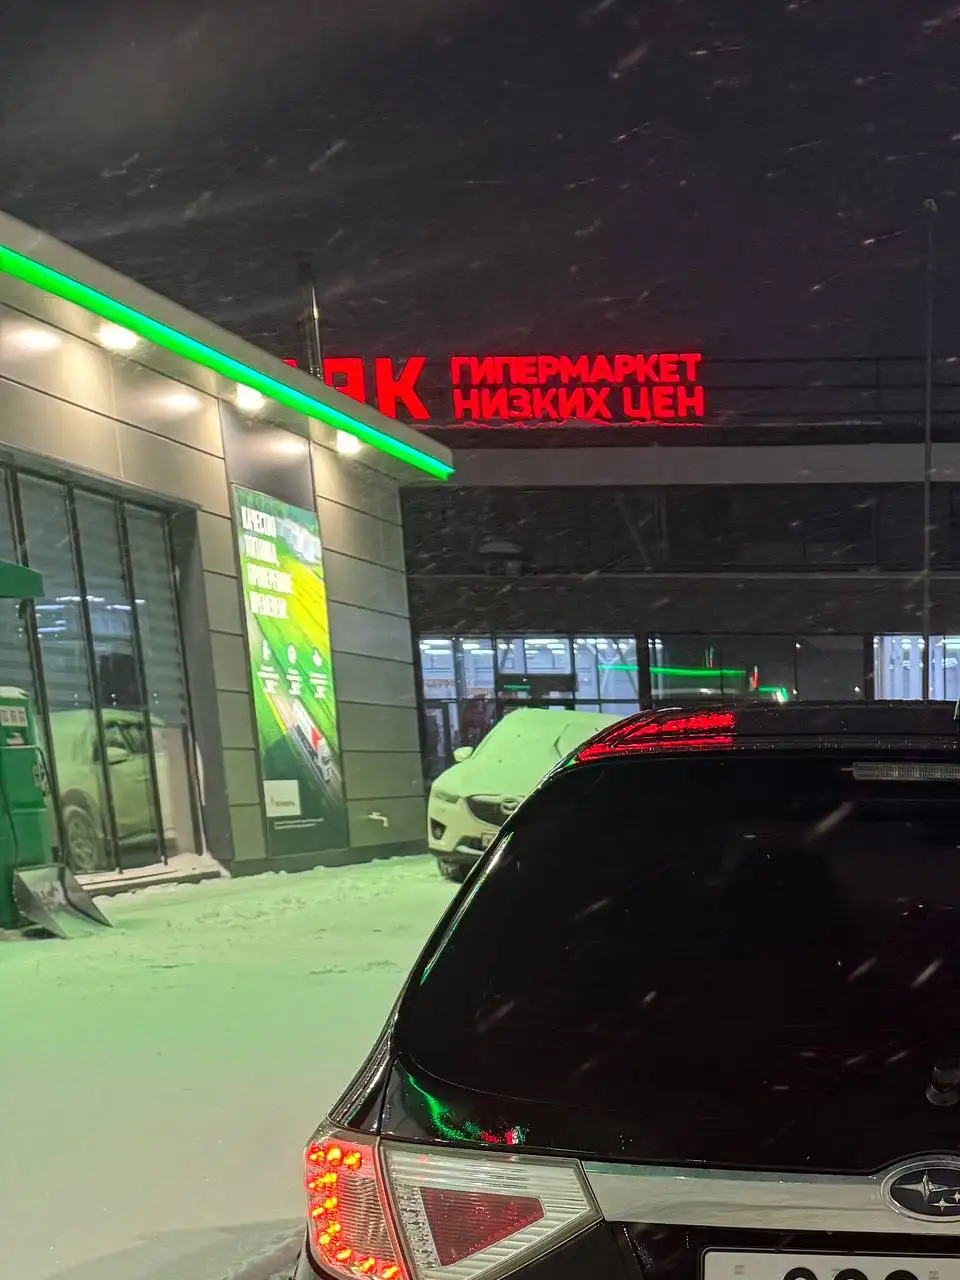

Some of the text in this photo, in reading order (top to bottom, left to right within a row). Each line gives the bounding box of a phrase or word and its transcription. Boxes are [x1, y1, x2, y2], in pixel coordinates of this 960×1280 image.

[450, 353, 702, 385] ГИПЕРМАРКЕТ
[281, 356, 431, 420] ЯК
[453, 386, 704, 421] НИЗКИХ ЦЕН
